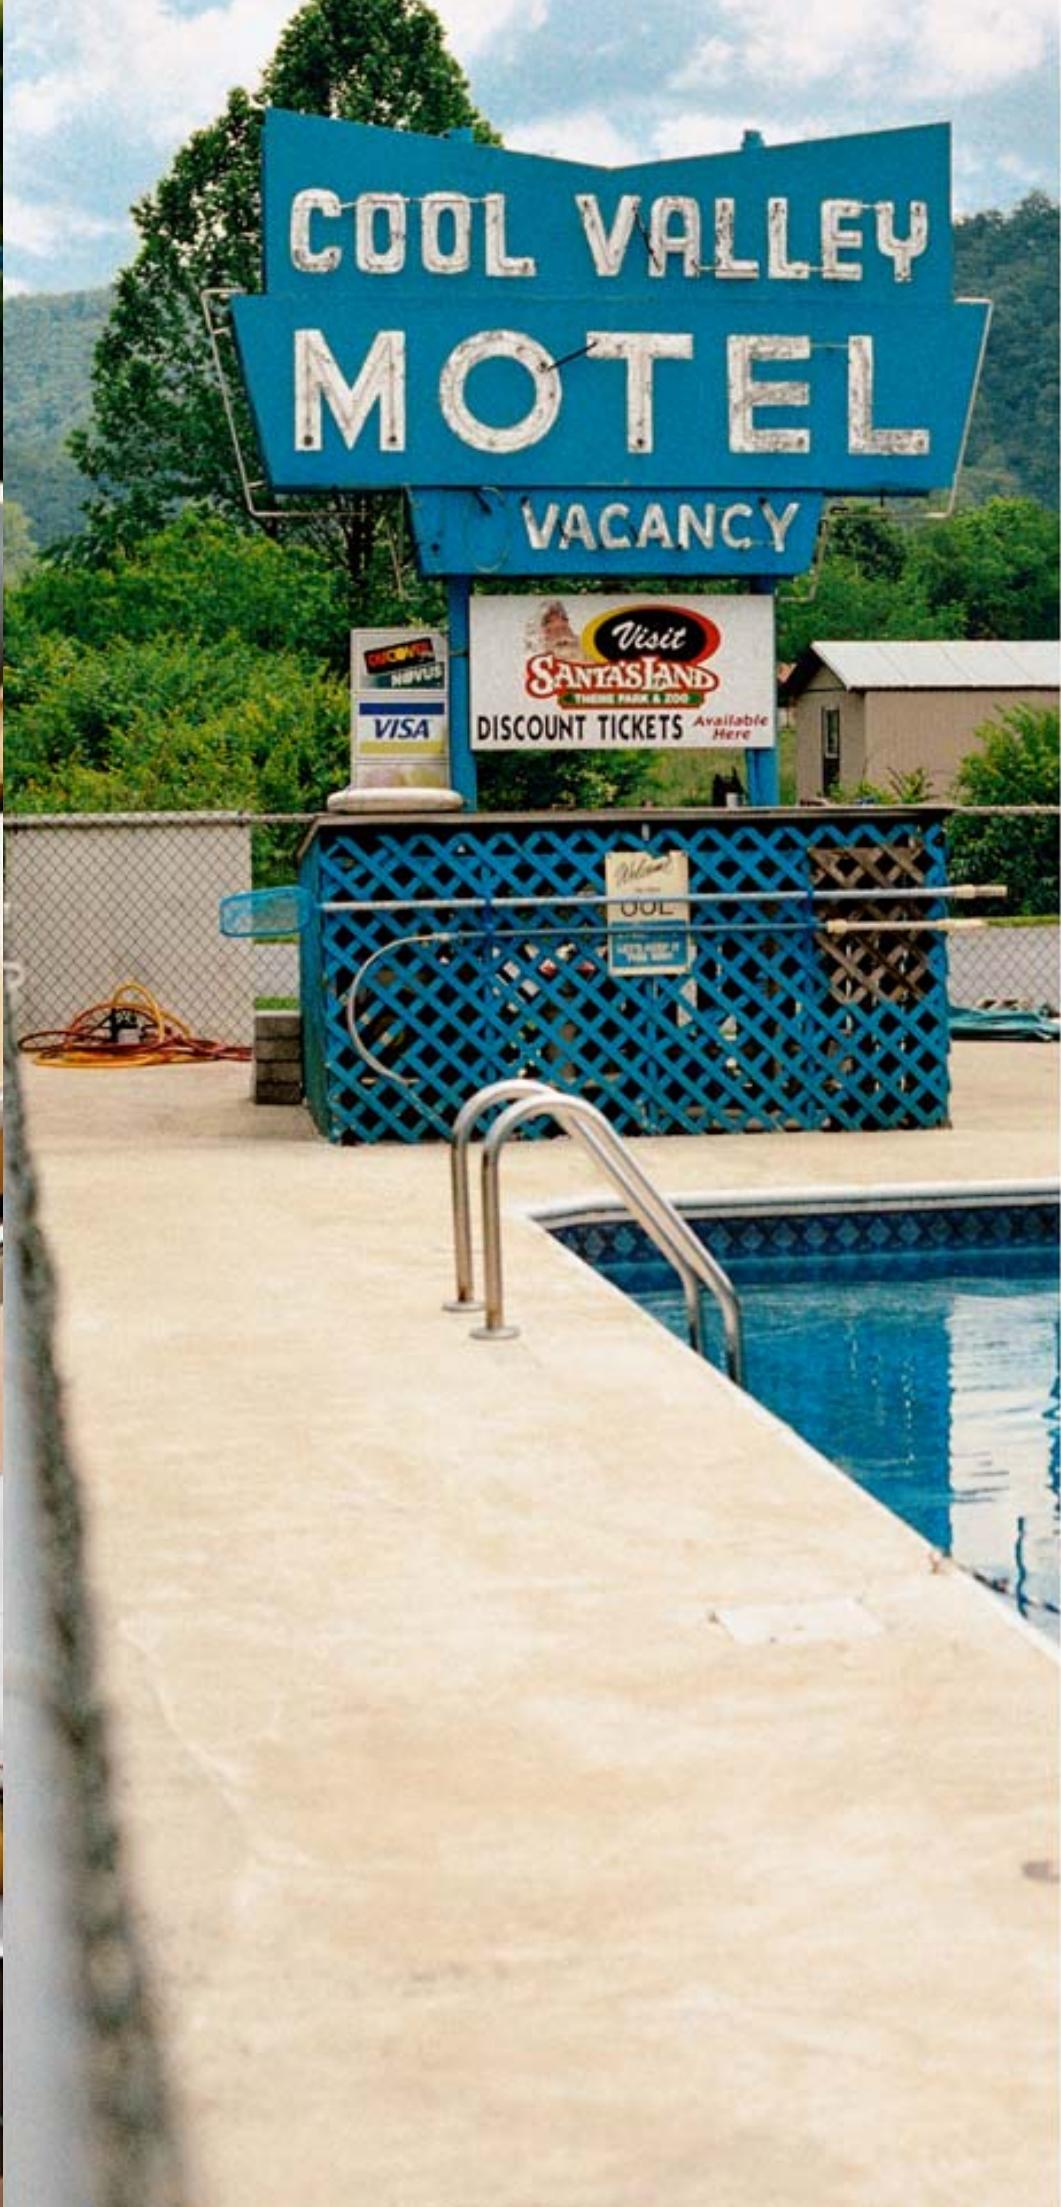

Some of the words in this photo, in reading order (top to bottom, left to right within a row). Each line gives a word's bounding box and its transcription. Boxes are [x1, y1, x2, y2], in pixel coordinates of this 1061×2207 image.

[289, 187, 537, 279] COOL
[574, 193, 928, 283] VALLEY
[293, 328, 931, 455] MOTEL
[521, 501, 801, 553] VACANCY
[610, 620, 688, 651] Visit
[618, 693, 651, 704] PARK
[663, 693, 689, 704] ZOO
[374, 718, 430, 739] VISA
[477, 714, 586, 741] DISCOUNT
[598, 714, 684, 741] TICKETS
[693, 713, 769, 728] Available
[711, 727, 752, 740] Here
